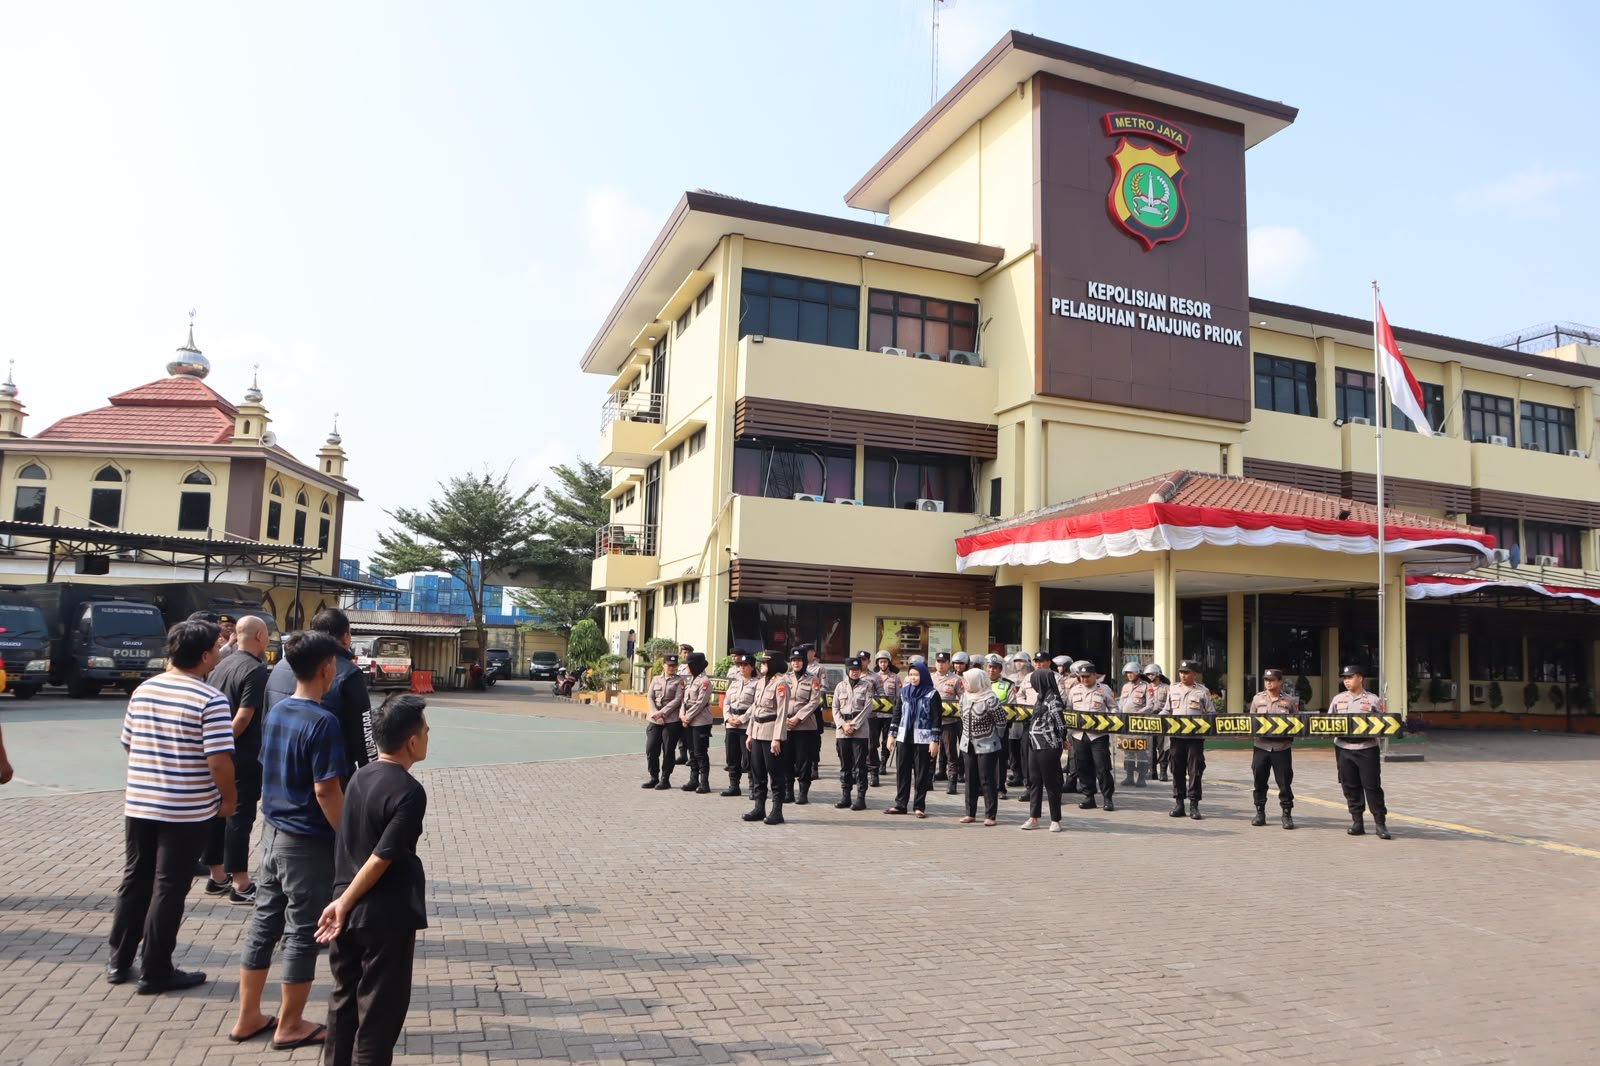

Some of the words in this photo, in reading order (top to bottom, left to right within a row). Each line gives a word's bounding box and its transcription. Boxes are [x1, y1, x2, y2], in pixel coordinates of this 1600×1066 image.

[1115, 117, 1155, 131] METRO
[1157, 124, 1183, 144] JAYA
[1088, 281, 1166, 311] KEPOLISIAN
[1170, 295, 1212, 319] RESOR
[1052, 297, 1135, 328] PELABUHAN
[1138, 312, 1201, 339] TANJUNG
[1204, 324, 1243, 347] PRIOK
[113, 649, 150, 658] POLISI
[1131, 718, 1160, 731] POLISI
[1217, 718, 1250, 732] POLISI
[1311, 718, 1346, 732] POLISI
[362, 710, 377, 757] NUSANTARA
[1117, 737, 1147, 750] POLISI
